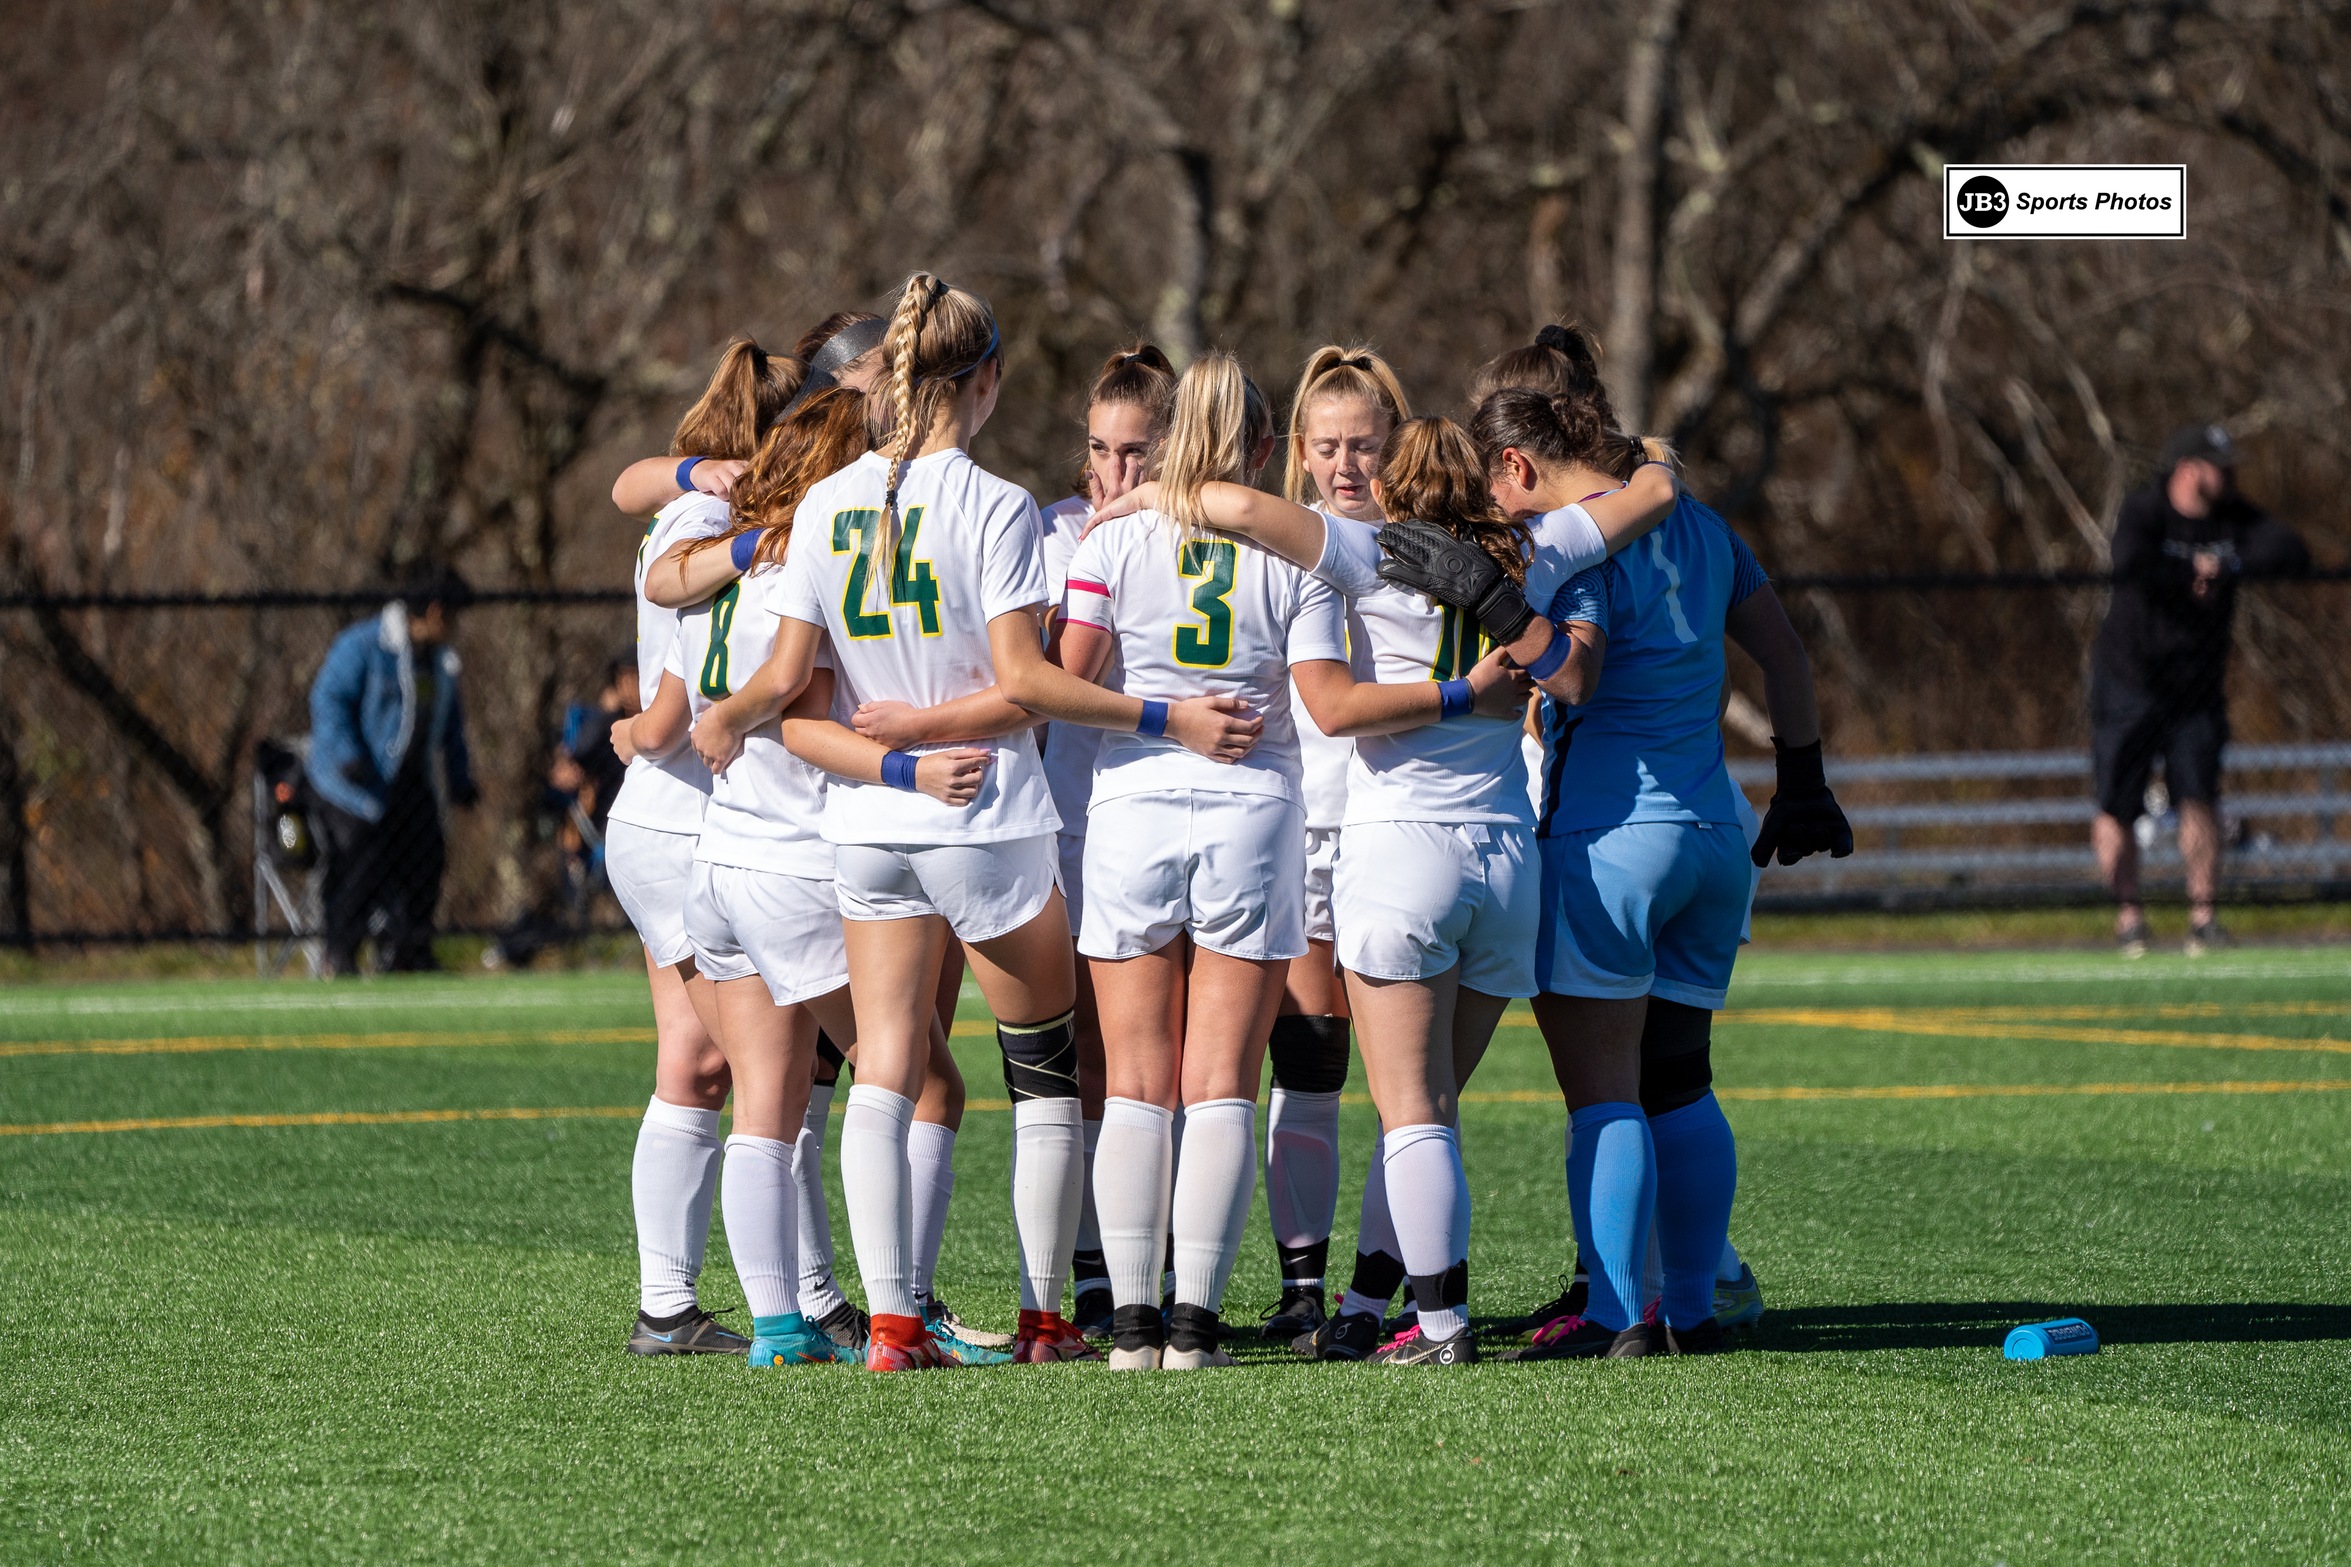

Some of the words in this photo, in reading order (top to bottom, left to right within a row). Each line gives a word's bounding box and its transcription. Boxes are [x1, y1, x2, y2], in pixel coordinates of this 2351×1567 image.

[830, 504, 943, 641] 24
[1172, 537, 1240, 670] 3
[698, 578, 741, 704] 8
